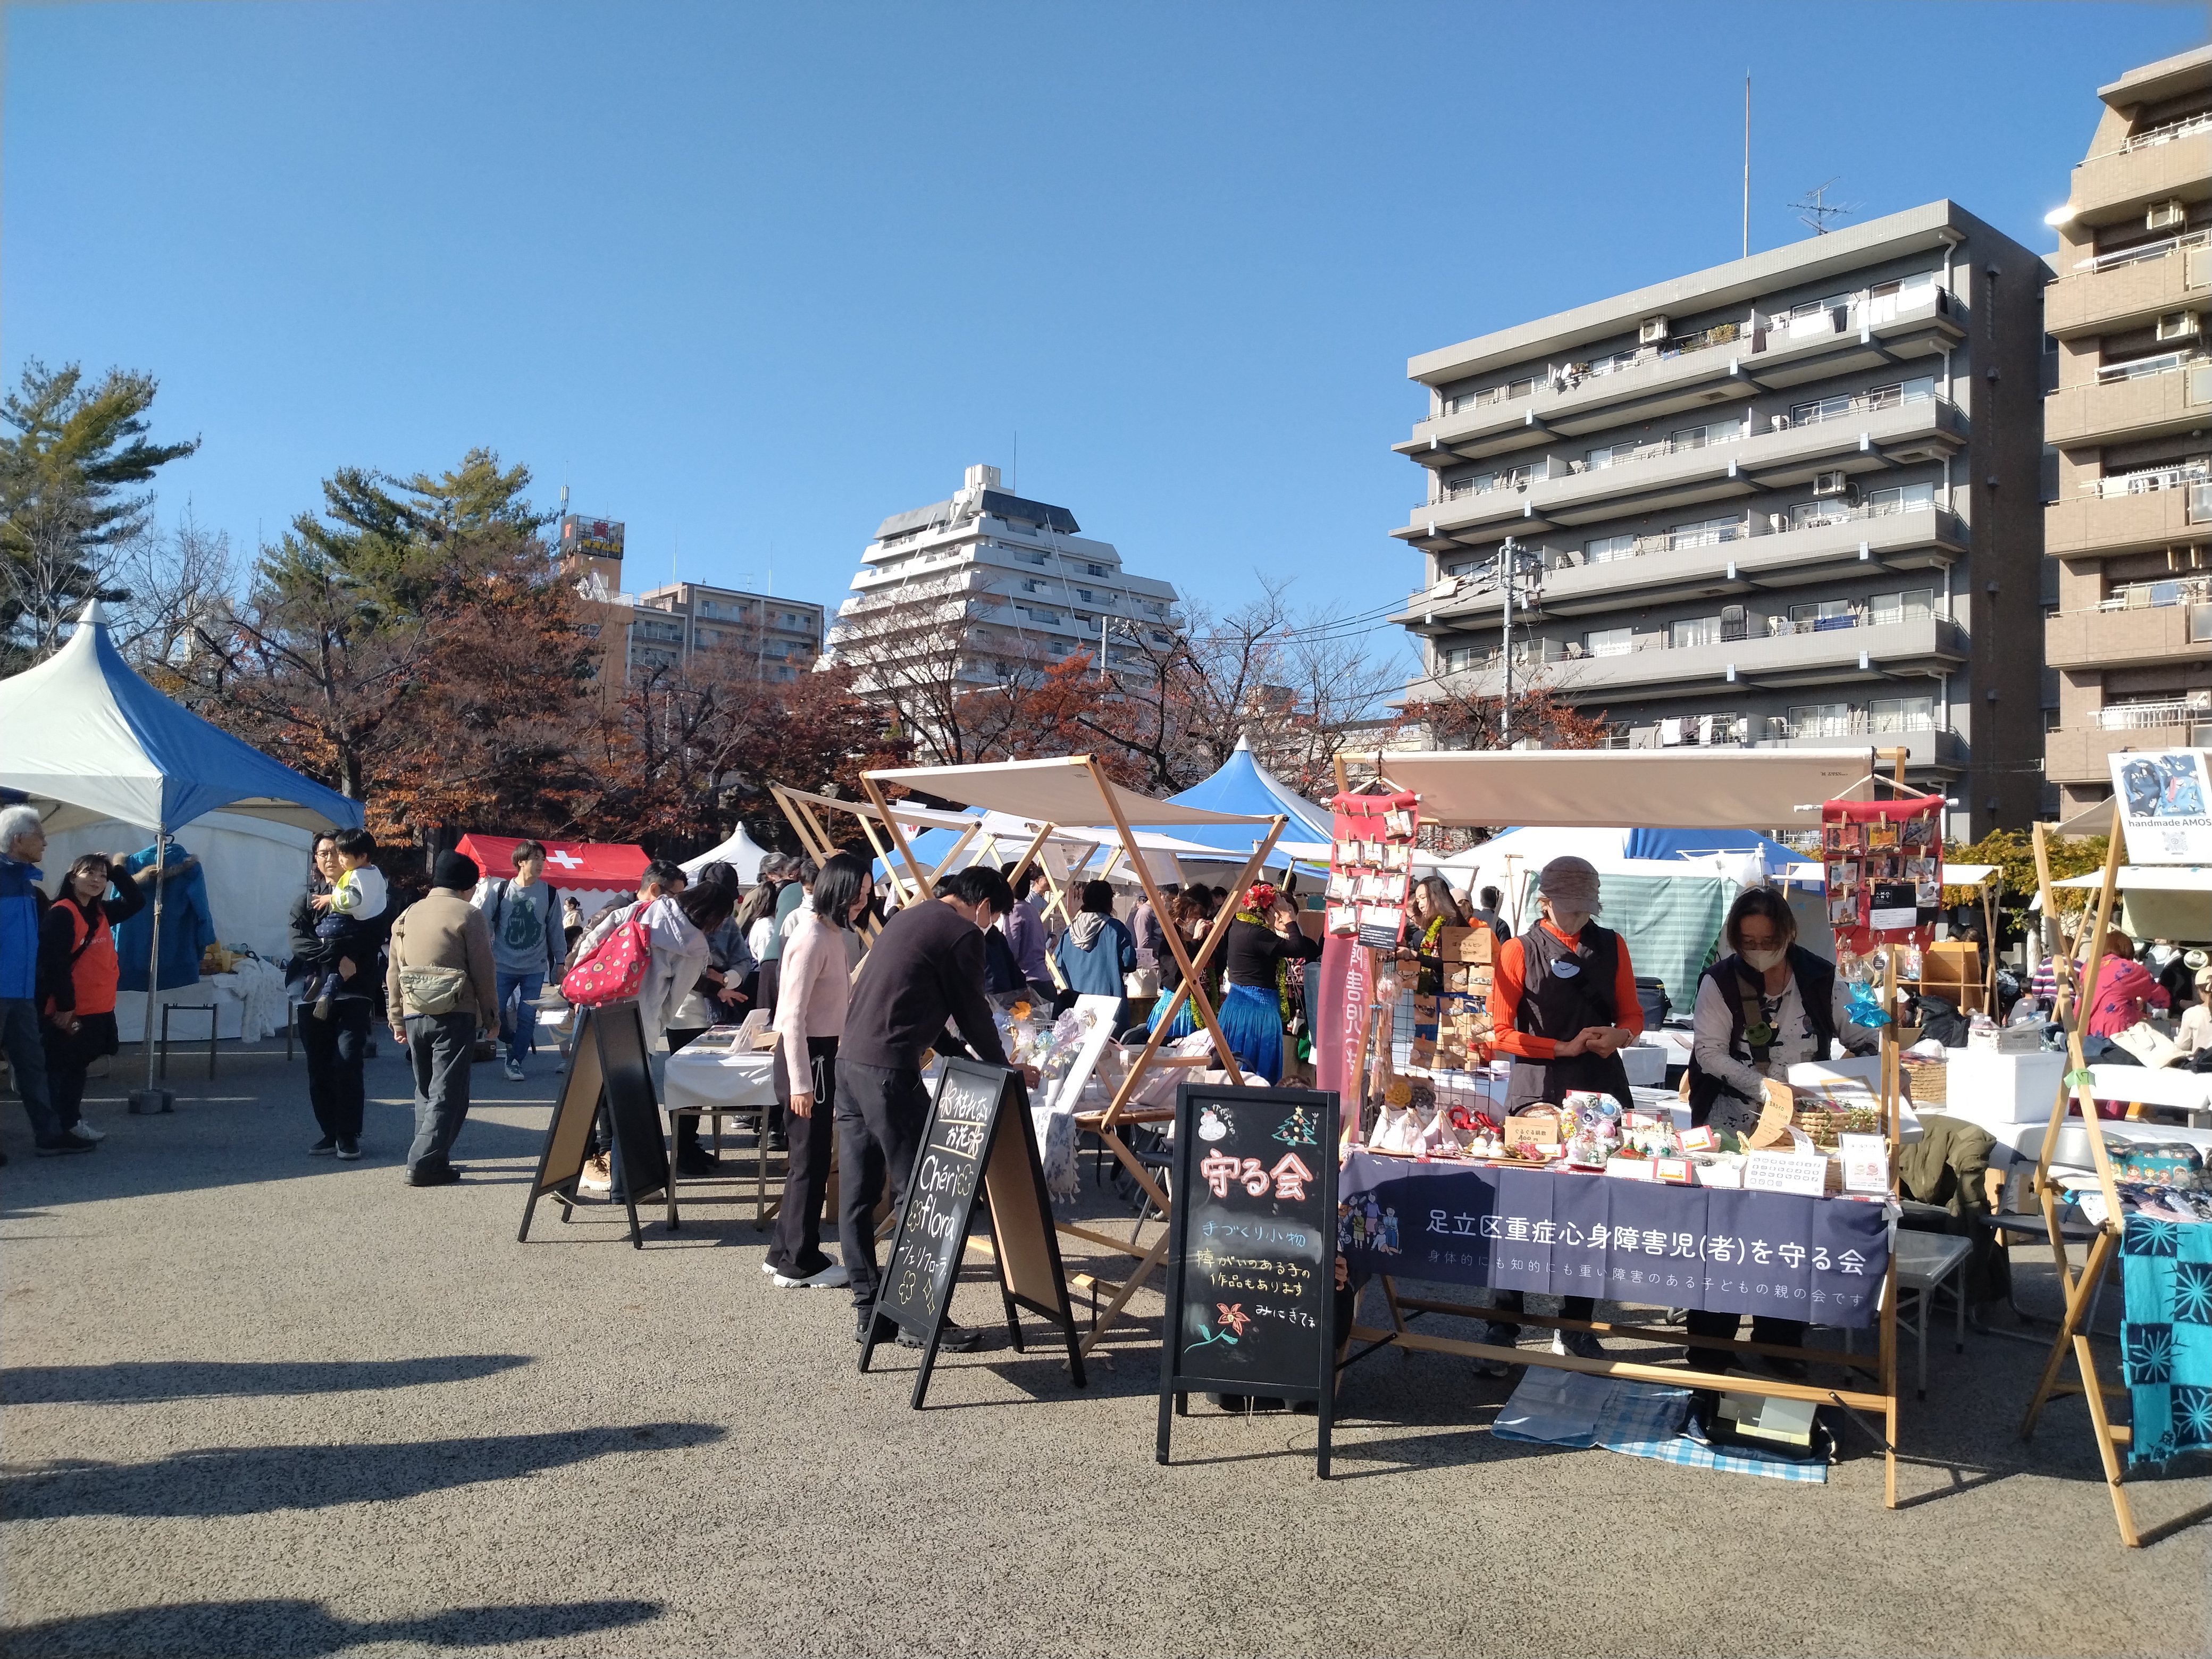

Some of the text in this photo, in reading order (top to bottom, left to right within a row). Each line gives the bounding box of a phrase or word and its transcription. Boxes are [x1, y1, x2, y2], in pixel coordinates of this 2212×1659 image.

[2076, 1072, 2089, 1083] 17
[953, 1088, 992, 1122] 枯れない
[946, 1125, 969, 1150] お花
[920, 1154, 961, 1197] Chéri
[1201, 1147, 1313, 1201] 守る会
[920, 1194, 956, 1242] flora
[1202, 1220, 1306, 1247] 手づくり小物
[1426, 1209, 1866, 1276] 足立区重症心身障害児(者)を守る会
[1197, 1247, 1310, 1279] 障がいのある子の
[1428, 1249, 1864, 1308] 身体的にも知的にも重い障害のある子どもの親の会です
[1210, 1272, 1303, 1296] 作品もあります
